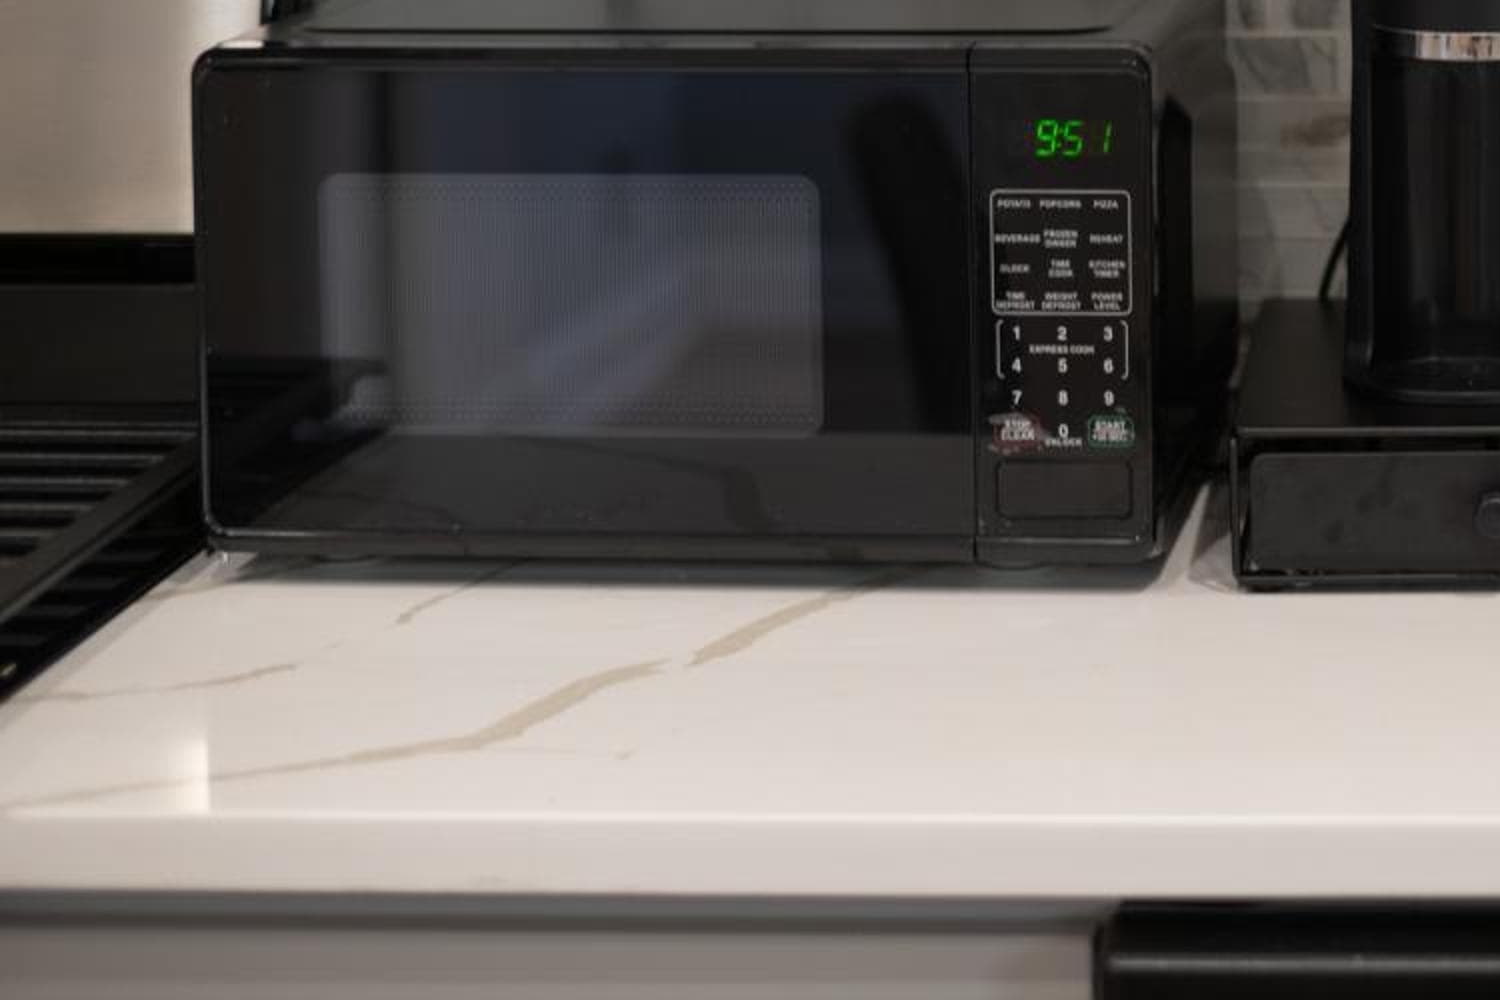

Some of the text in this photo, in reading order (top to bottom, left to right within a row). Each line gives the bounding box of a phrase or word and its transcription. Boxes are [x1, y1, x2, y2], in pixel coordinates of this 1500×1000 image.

[1035, 119, 1112, 157] 9:51
[1013, 325, 1021, 341] 1
[1057, 325, 1067, 341] 2
[1103, 325, 1113, 341] 3
[1011, 357, 1021, 373] 4
[1058, 357, 1068, 373] 5
[1103, 358, 1114, 374] 6
[1011, 389, 1022, 405] 7
[1058, 389, 1069, 406] 8
[1104, 389, 1114, 406] 9
[1058, 423, 1069, 438] 0
